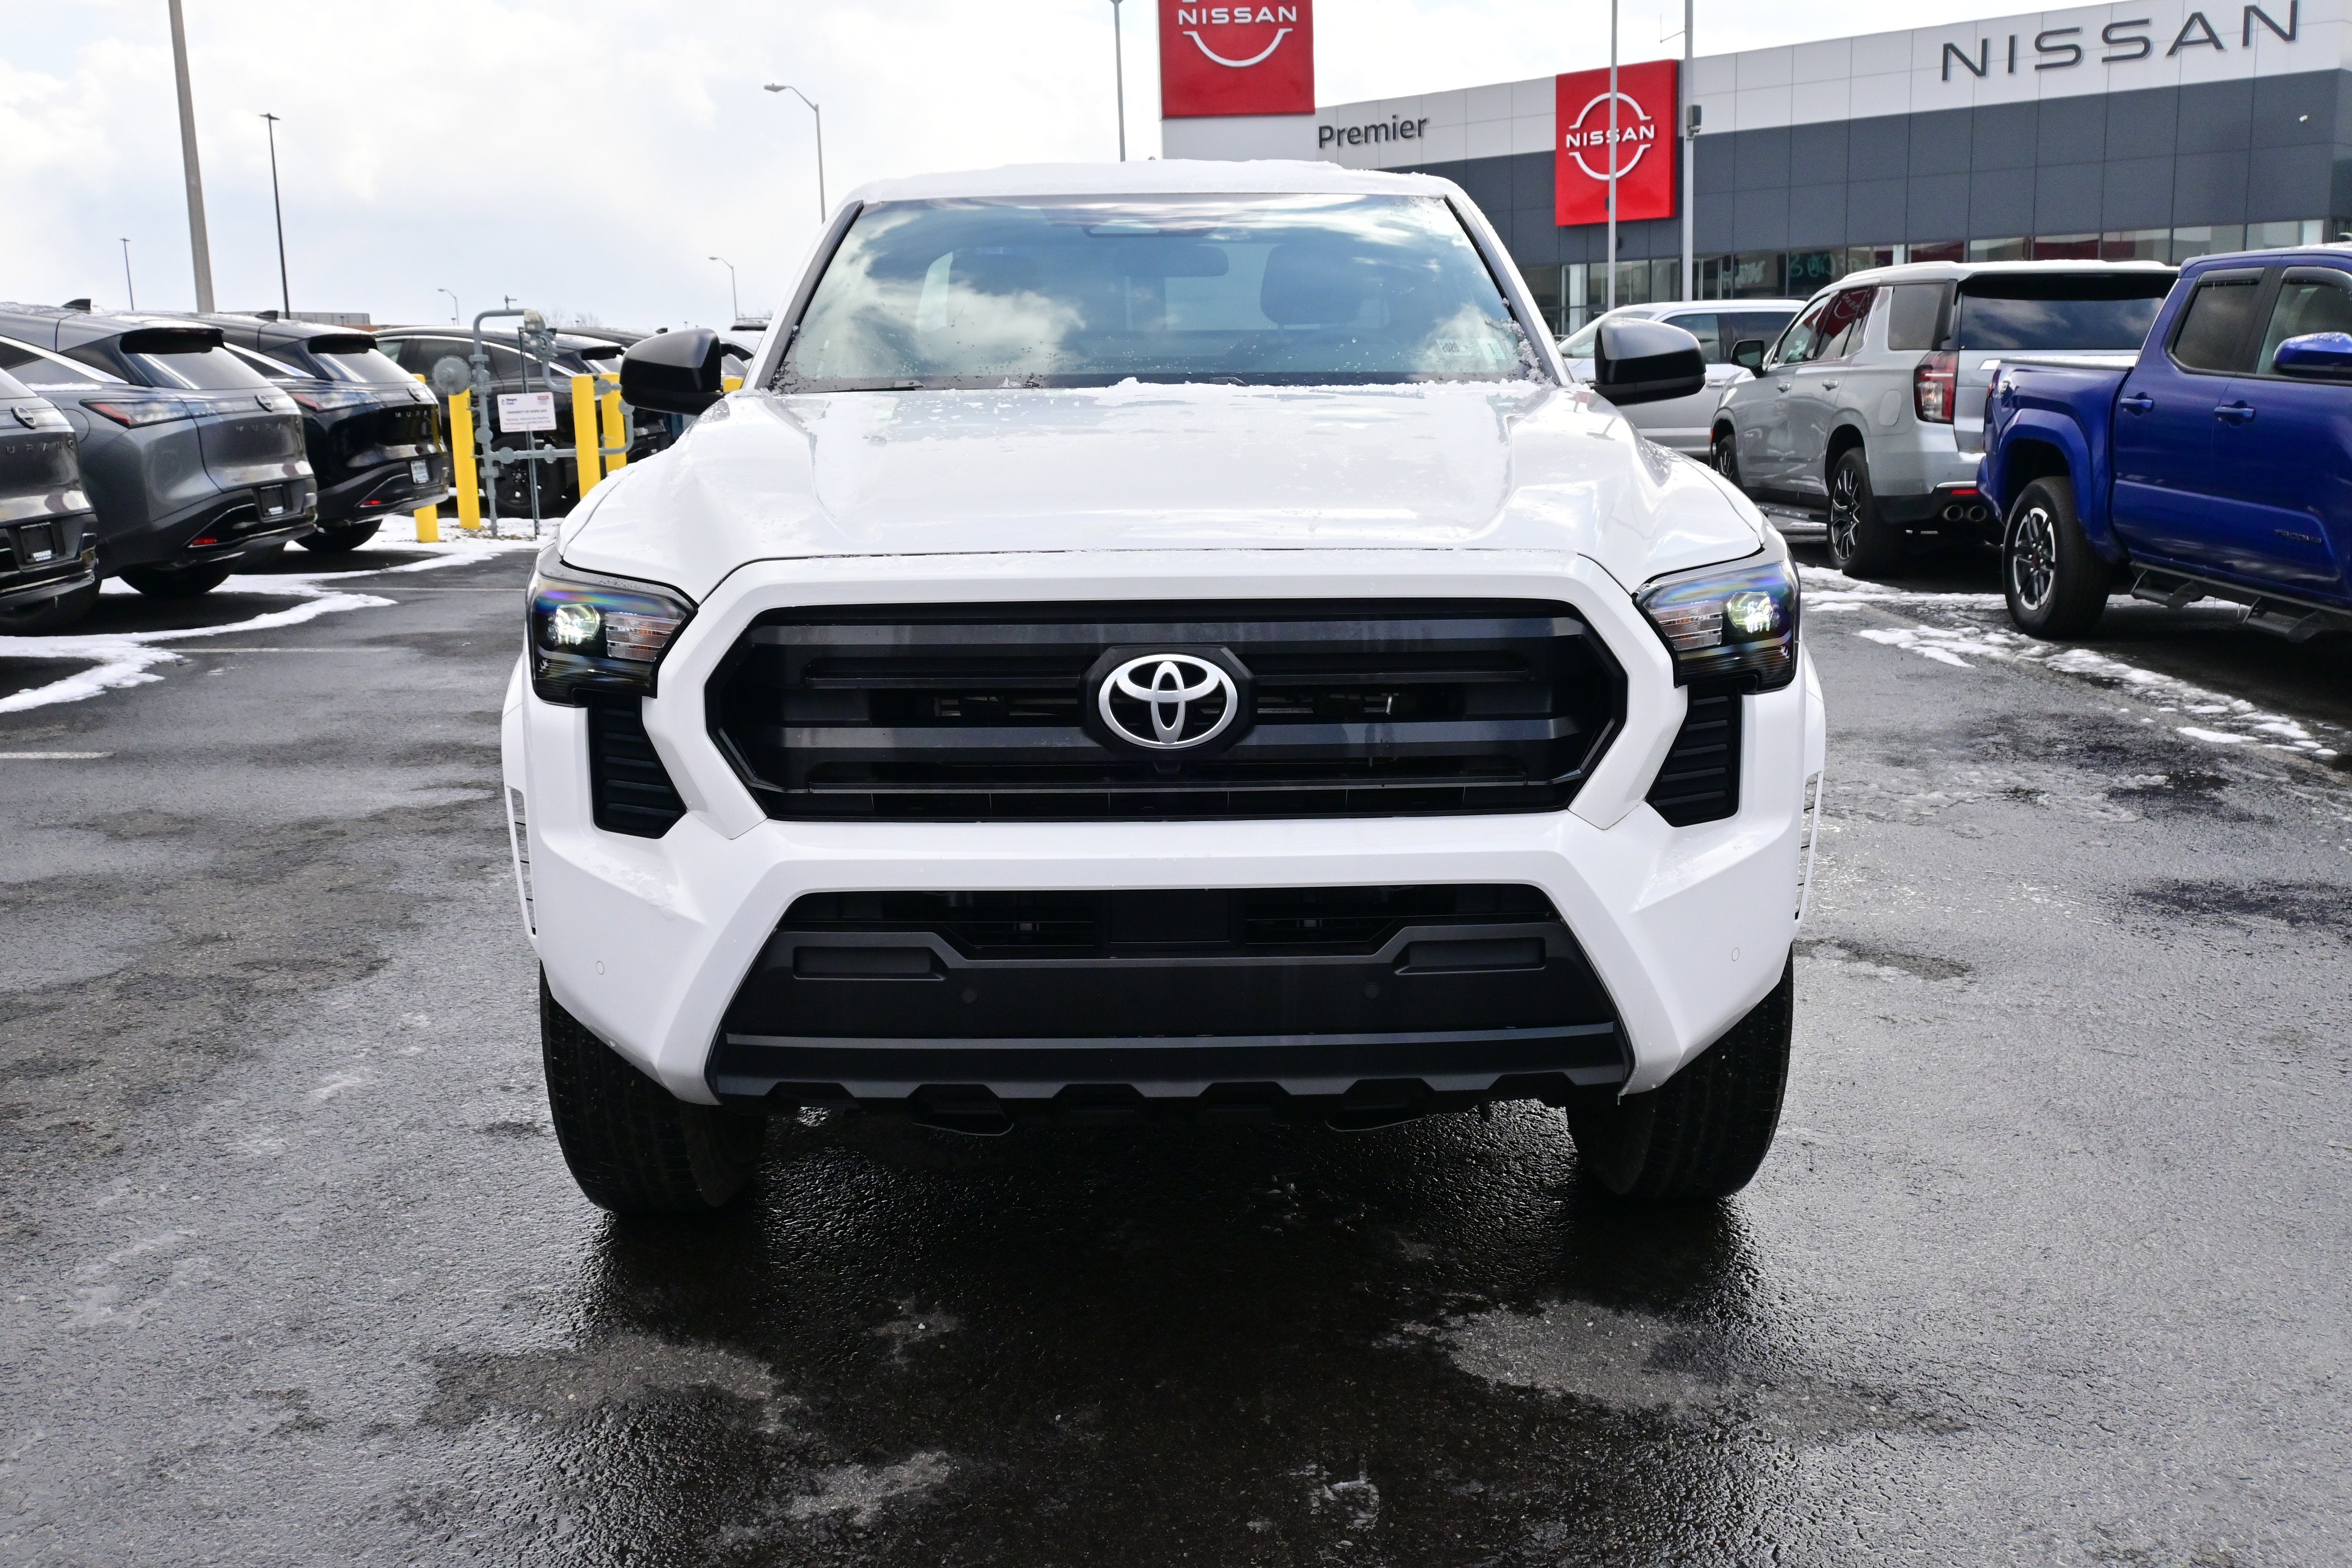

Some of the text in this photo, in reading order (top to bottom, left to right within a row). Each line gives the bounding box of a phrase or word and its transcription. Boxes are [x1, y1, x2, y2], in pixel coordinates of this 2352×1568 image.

[1178, 5, 1297, 25] NISSAN
[1942, 0, 2300, 82] NISSAN
[1318, 114, 1429, 149] Premier
